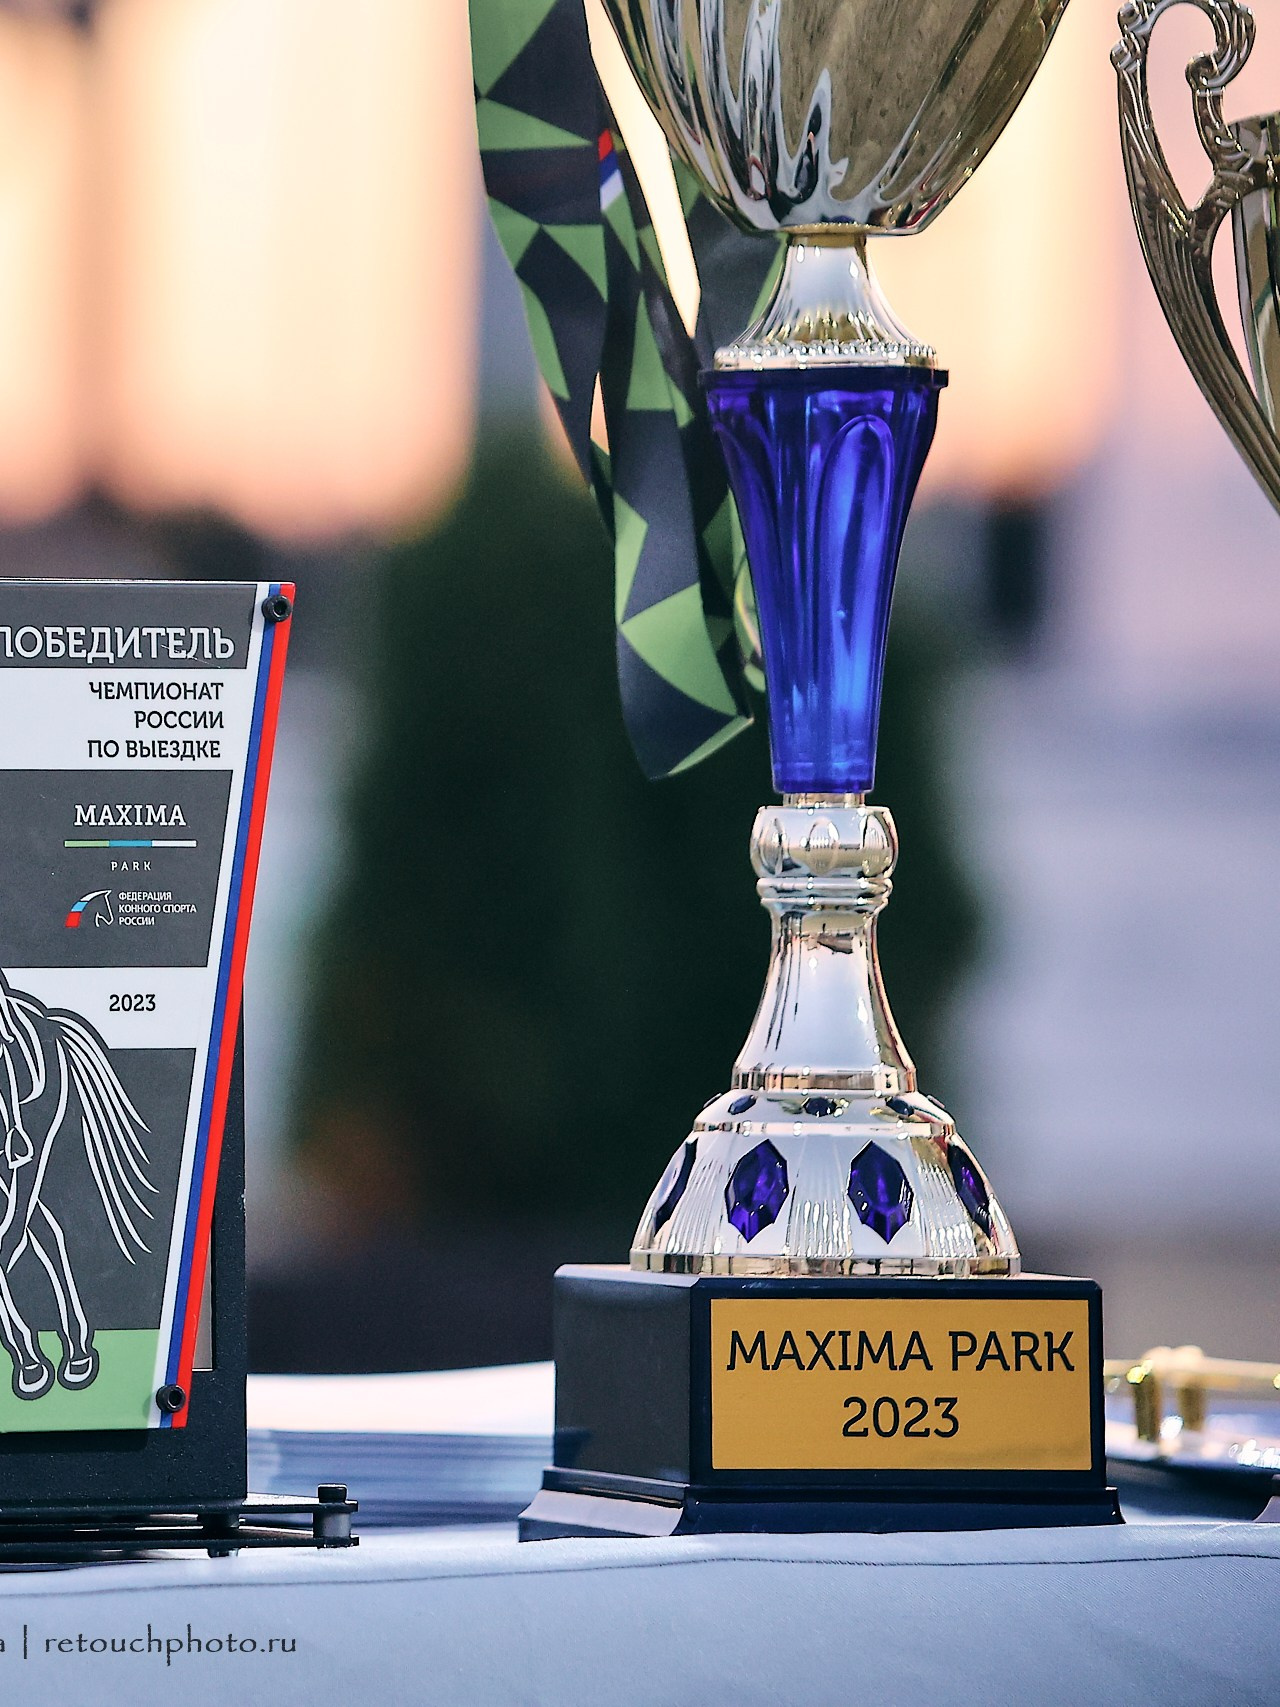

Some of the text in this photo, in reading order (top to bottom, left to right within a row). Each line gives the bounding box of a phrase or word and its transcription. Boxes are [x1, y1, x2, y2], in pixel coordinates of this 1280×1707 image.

[88, 681, 224, 701] ЧЕМПИОНАТ
[133, 710, 225, 729] РОССИИ
[87, 739, 221, 762] ПО ВЫЕЗДКЕ
[73, 804, 187, 826] MAXIMA
[110, 861, 151, 871] PARK
[118, 891, 172, 902] ФЕДЕРАЦИЯ
[118, 903, 197, 914] КОННОГО СПОРТА
[118, 916, 155, 926] РОССИИ
[109, 993, 156, 1012] 2023
[726, 1330, 1075, 1372] MAXIMA PARK
[842, 1396, 959, 1439] 2023
